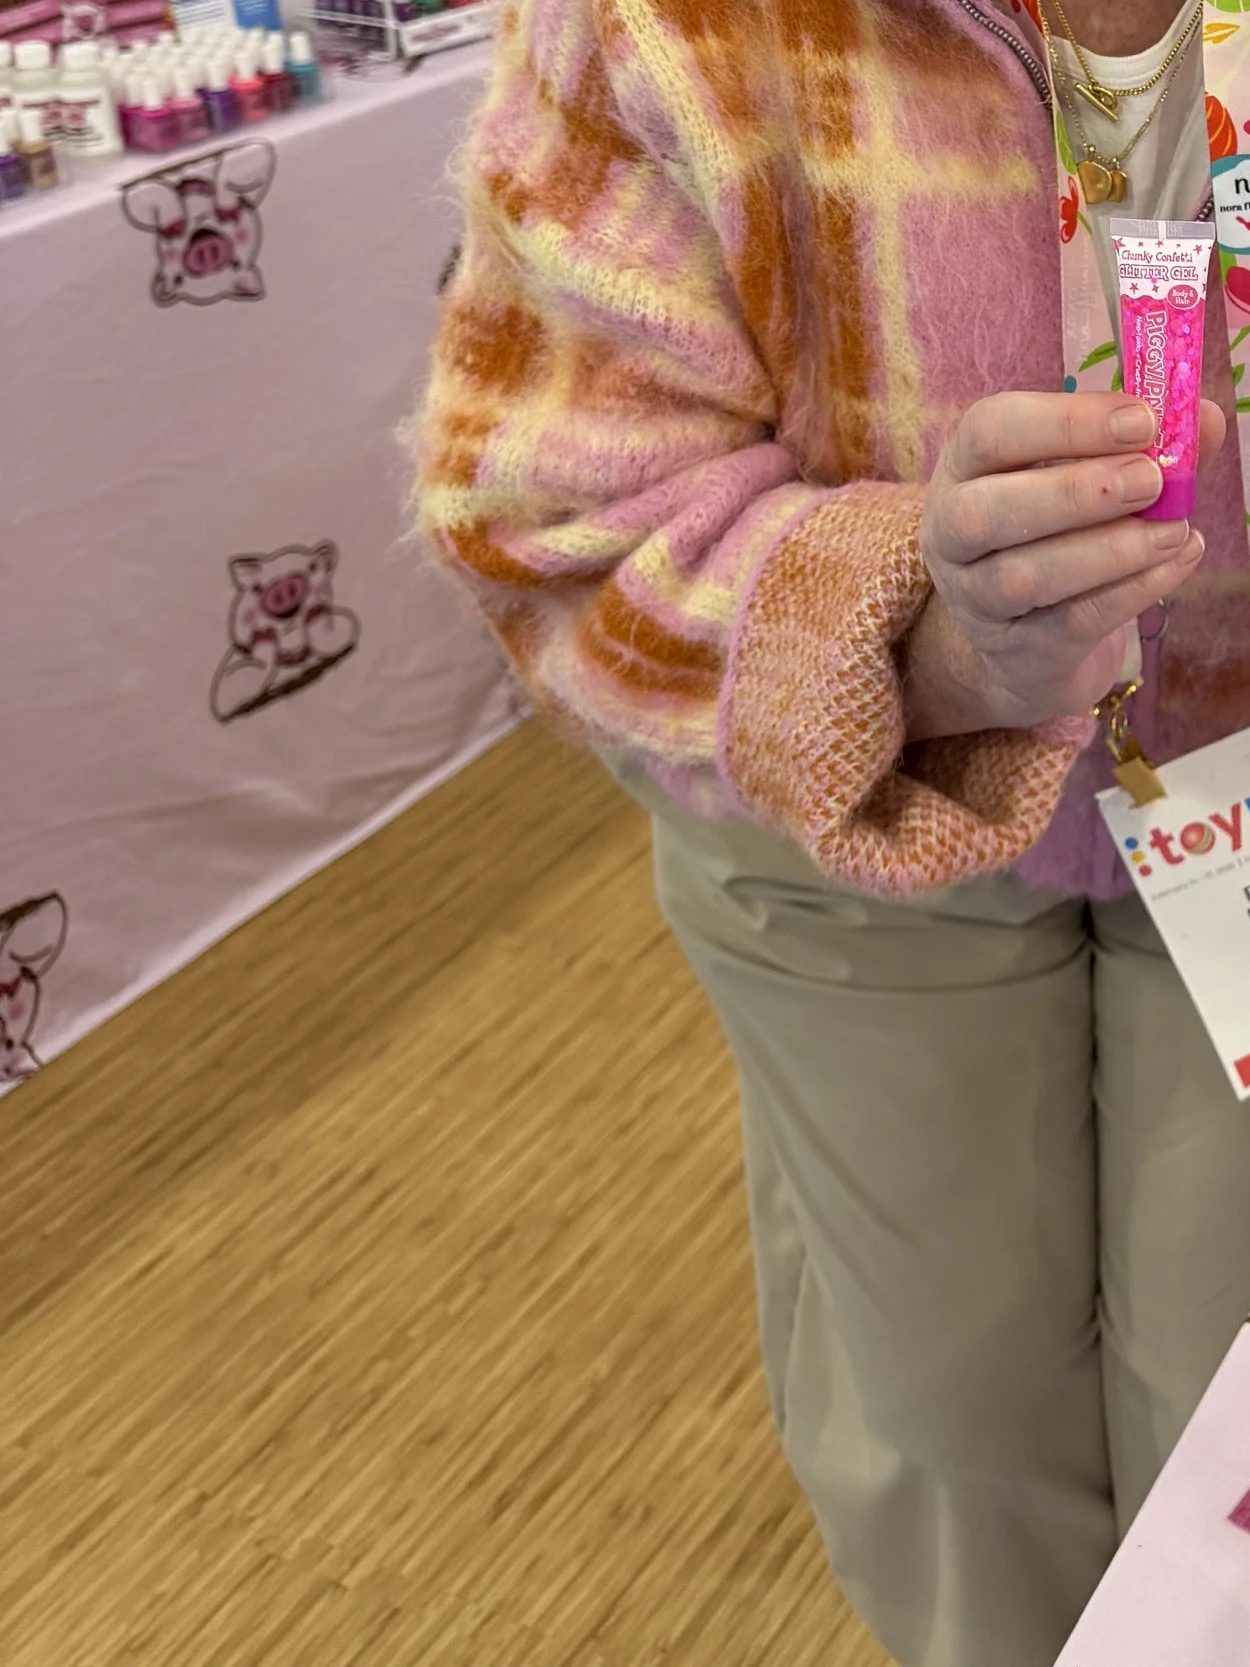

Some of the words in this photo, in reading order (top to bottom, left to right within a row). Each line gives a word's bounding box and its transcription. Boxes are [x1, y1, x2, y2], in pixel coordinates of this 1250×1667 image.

[1219, 204, 1243, 213] nora
[1121, 250, 1153, 264] Chunky
[1156, 252, 1193, 263] Confetti
[1118, 263, 1170, 282] GLITTER
[1170, 265, 1199, 281] GEL
[1141, 309, 1169, 378] PIGGY
